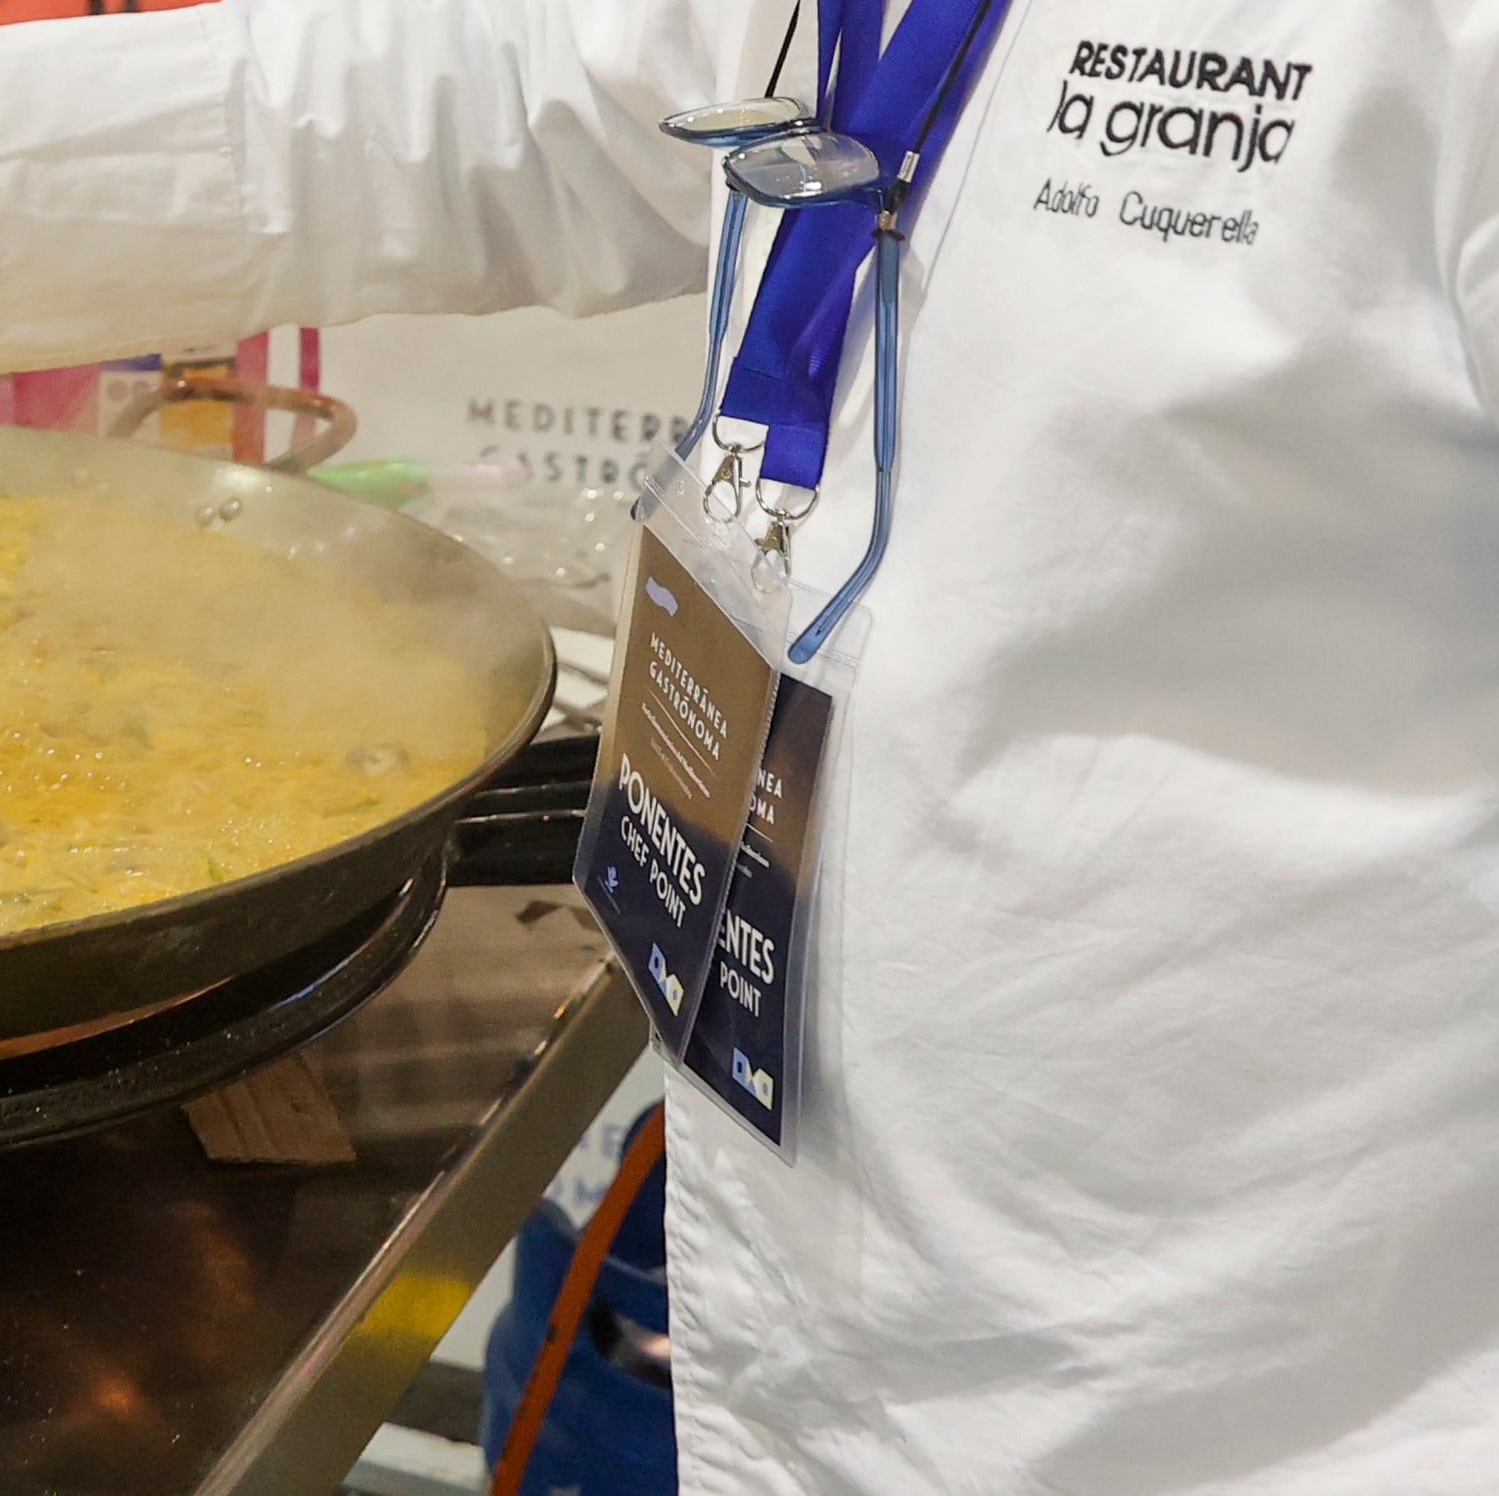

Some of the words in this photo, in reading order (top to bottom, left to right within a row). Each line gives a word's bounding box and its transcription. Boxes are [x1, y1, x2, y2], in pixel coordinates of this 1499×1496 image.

[1069, 40, 1313, 101] RESTAURANT
[1046, 79, 1095, 140] la
[1099, 100, 1296, 173] granja
[1033, 178, 1100, 218] Adolfo
[1119, 190, 1260, 246] Cuquerella
[618, 752, 706, 906] PONENTES
[620, 815, 650, 867] CHEF
[649, 858, 687, 928] POINT
[719, 961, 762, 1018] POINT
